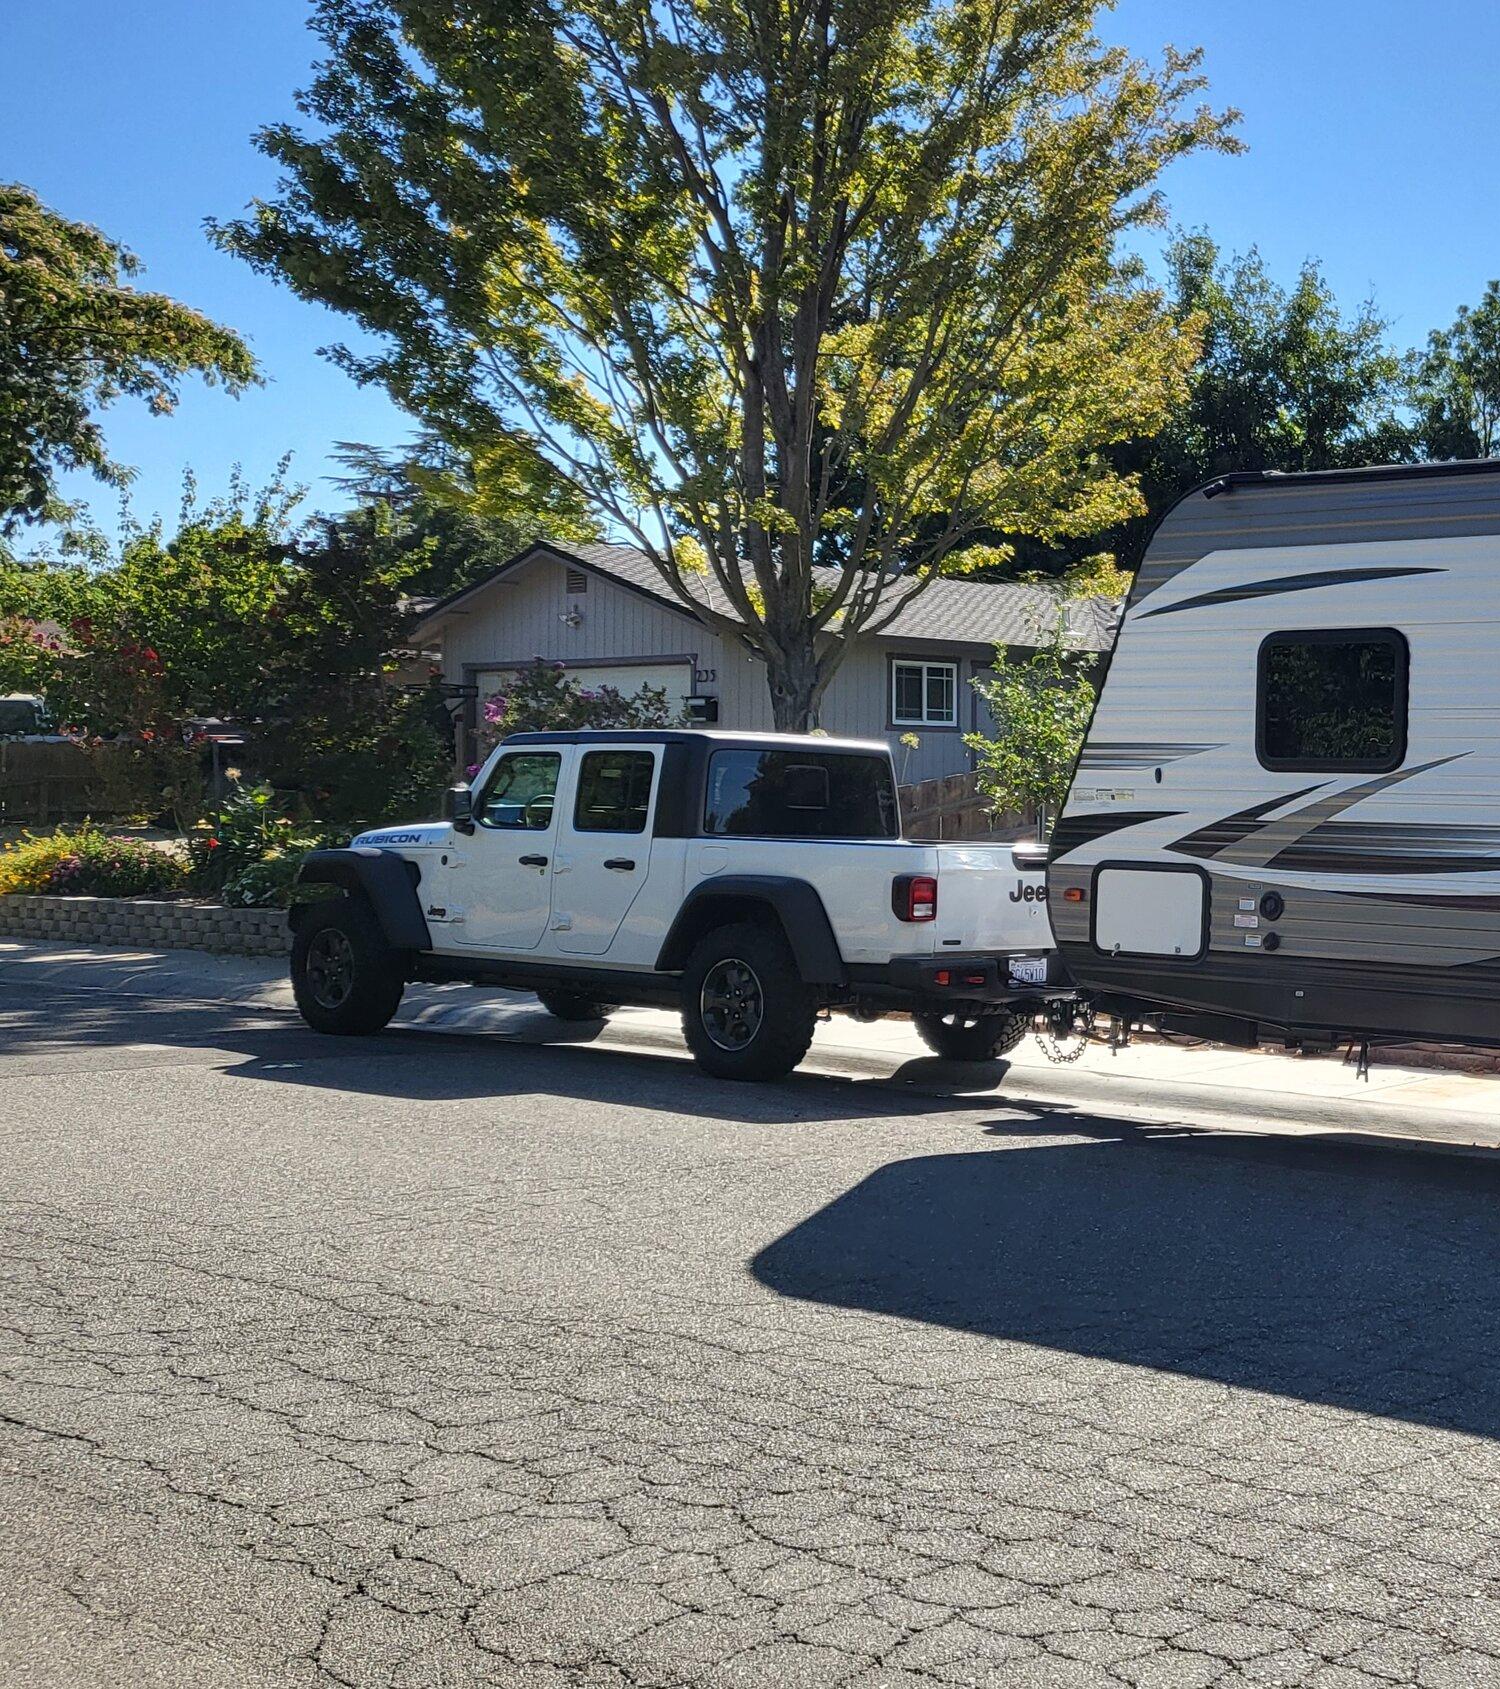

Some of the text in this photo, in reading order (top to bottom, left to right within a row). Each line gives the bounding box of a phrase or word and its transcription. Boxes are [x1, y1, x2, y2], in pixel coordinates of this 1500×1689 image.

[696, 669, 716, 683] 235
[355, 834, 421, 845] RUBICON
[1009, 879, 1047, 903] Jee
